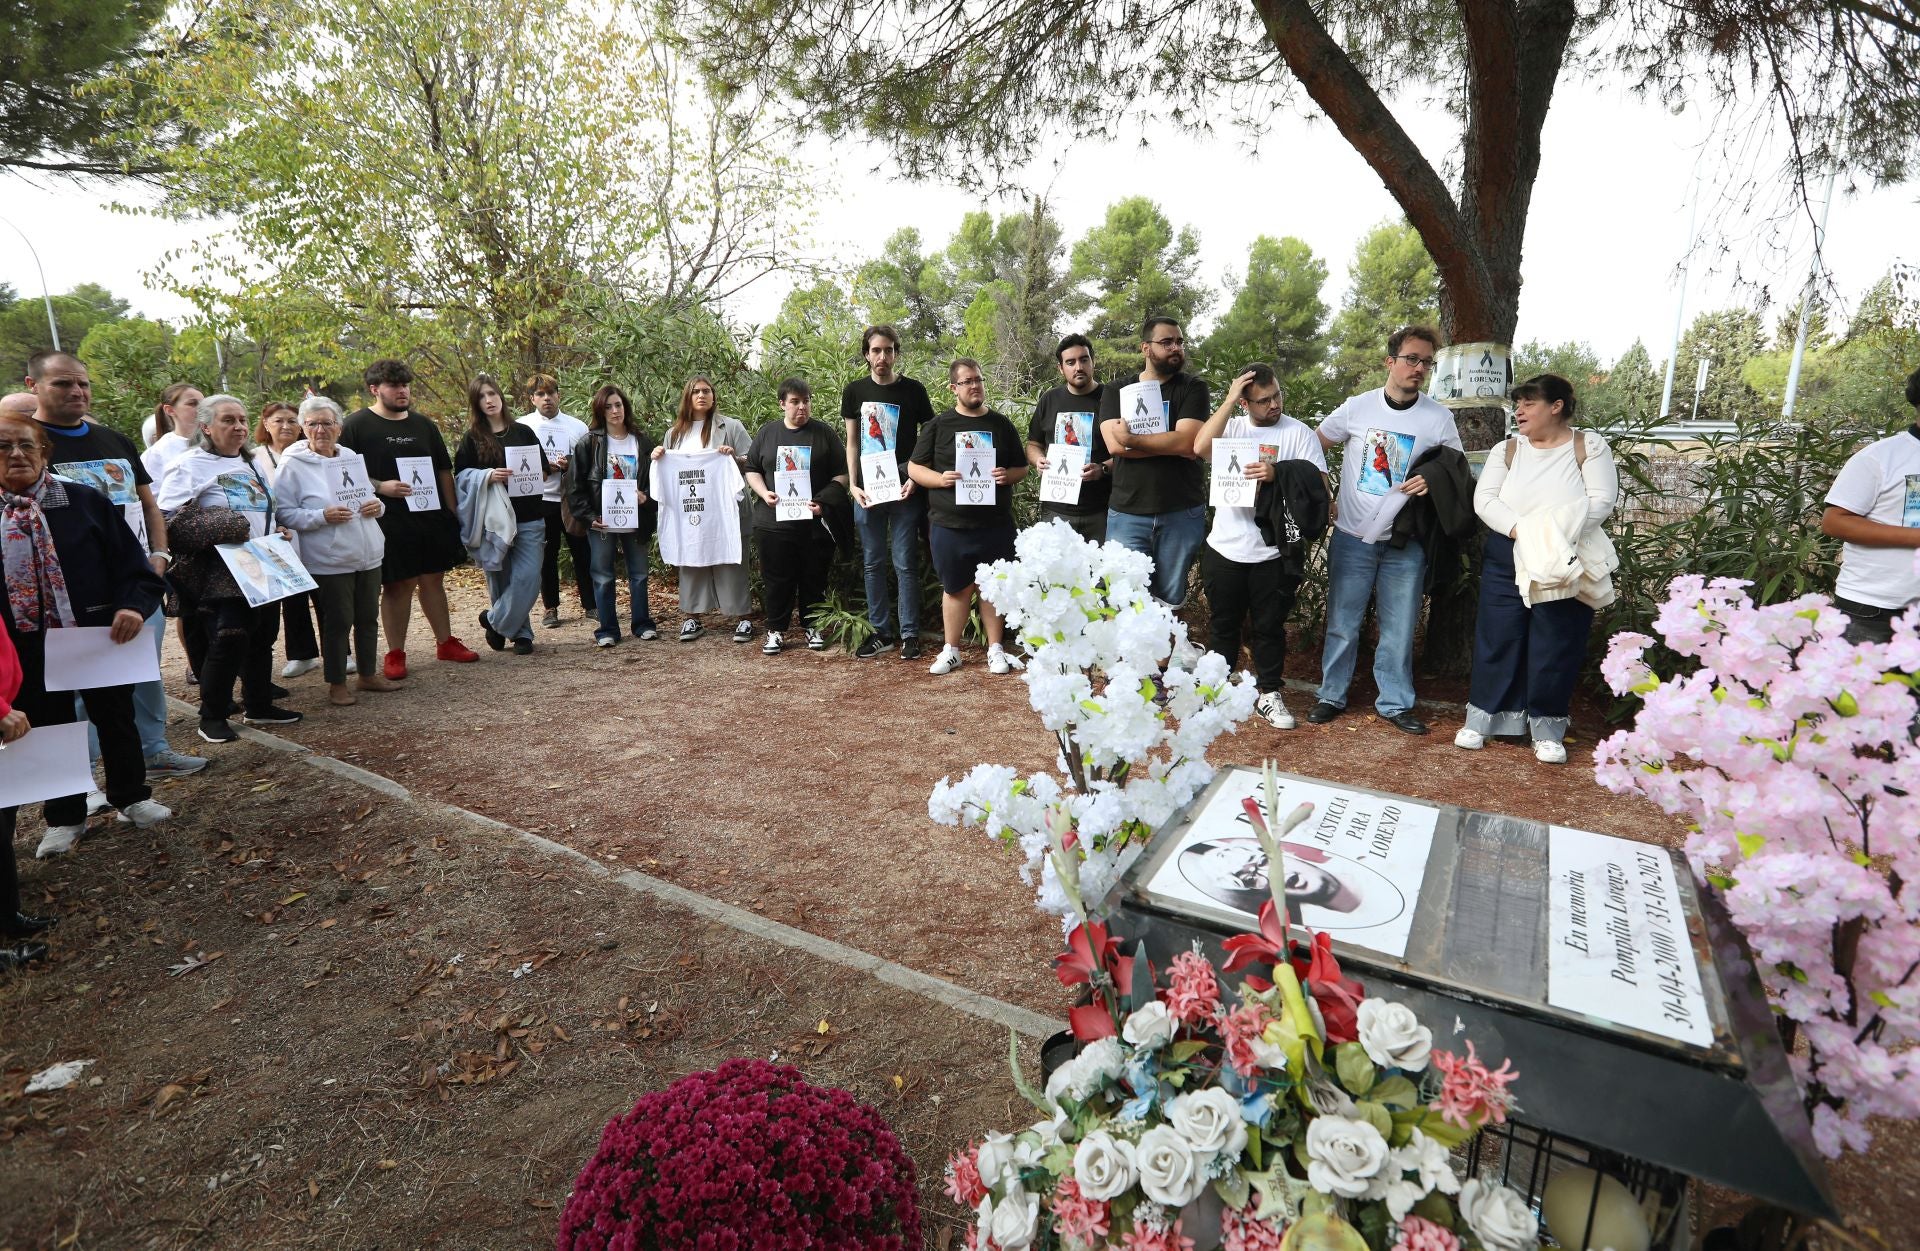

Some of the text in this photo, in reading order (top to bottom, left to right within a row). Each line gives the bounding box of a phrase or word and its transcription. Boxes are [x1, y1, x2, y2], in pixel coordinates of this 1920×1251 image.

[1469, 376, 1501, 384] LORENZO
[338, 492, 366, 502] LORENZO
[1314, 796, 1350, 845] JUSTICIA
[1345, 811, 1372, 841] PARA
[1369, 805, 1402, 859] LORENZO
[1563, 869, 1588, 954] En memoria
[1636, 851, 1672, 923] 31-10-2021
[1604, 862, 1641, 987] Pompiliu Lorenzo
[1650, 931, 1694, 1030] 30-04-2000
[1272, 1163, 1296, 1217] LORENZO
